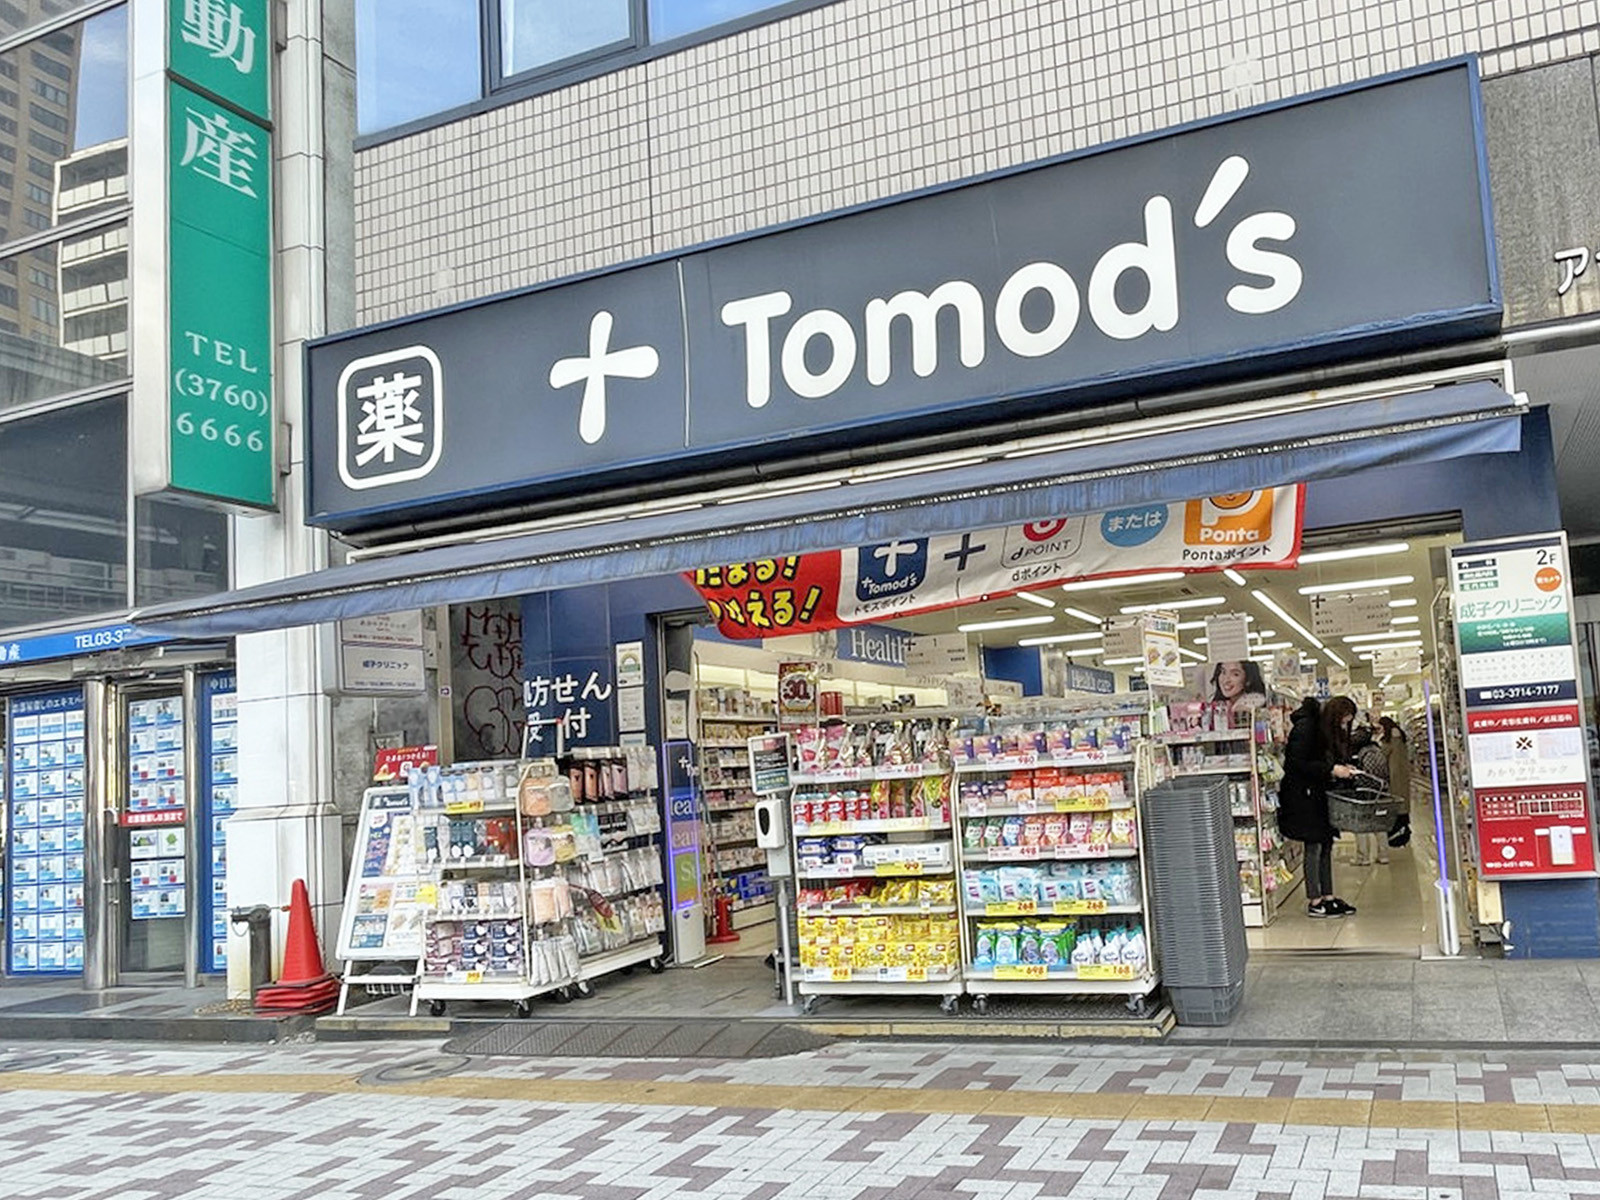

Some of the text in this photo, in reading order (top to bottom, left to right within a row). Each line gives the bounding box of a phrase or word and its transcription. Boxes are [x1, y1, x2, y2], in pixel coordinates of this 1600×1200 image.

[722, 155, 1303, 408] Tomod's
[1554, 247, 1600, 294] ア
[185, 331, 258, 374] TEL
[175, 367, 269, 416] (3760)
[176, 413, 264, 453] 6666
[355, 372, 425, 468] 薬
[1108, 511, 1162, 532] または
[1200, 527, 1260, 542] Ponta
[1182, 545, 1272, 561] Pontaポイント
[868, 573, 918, 595] Tomod's
[1012, 562, 1062, 582] dポイント
[1460, 595, 1563, 619] 成子クリニック
[74, 628, 131, 649] TEL03-3
[528, 707, 591, 743] 受付
